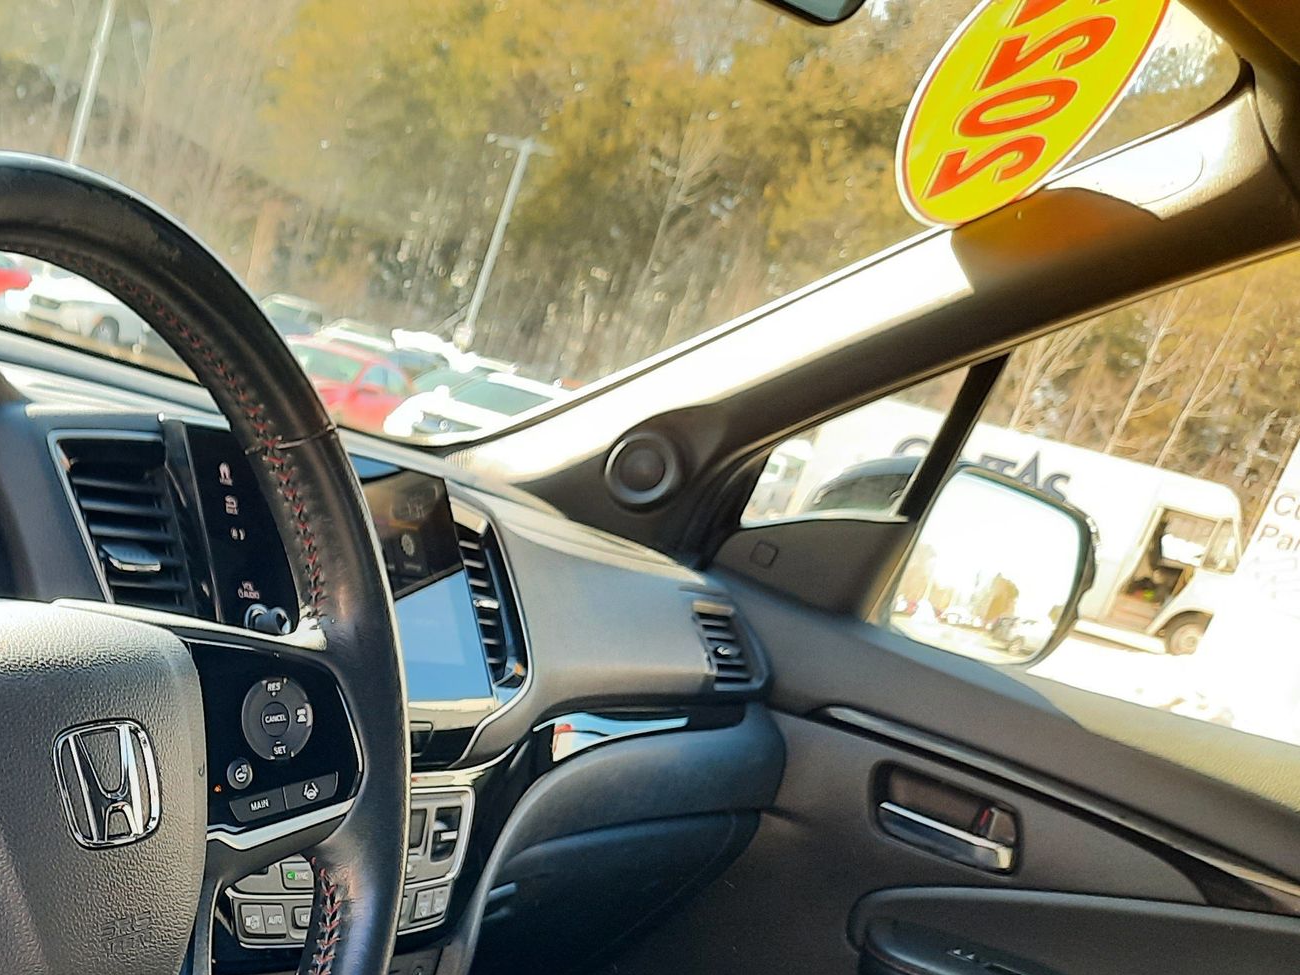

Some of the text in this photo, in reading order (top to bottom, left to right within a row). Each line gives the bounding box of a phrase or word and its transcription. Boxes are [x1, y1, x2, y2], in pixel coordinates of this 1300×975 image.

[266, 681, 281, 692] RES
[264, 713, 287, 724] CANCEL
[273, 745, 287, 756] SET
[250, 799, 270, 812] MAIN
